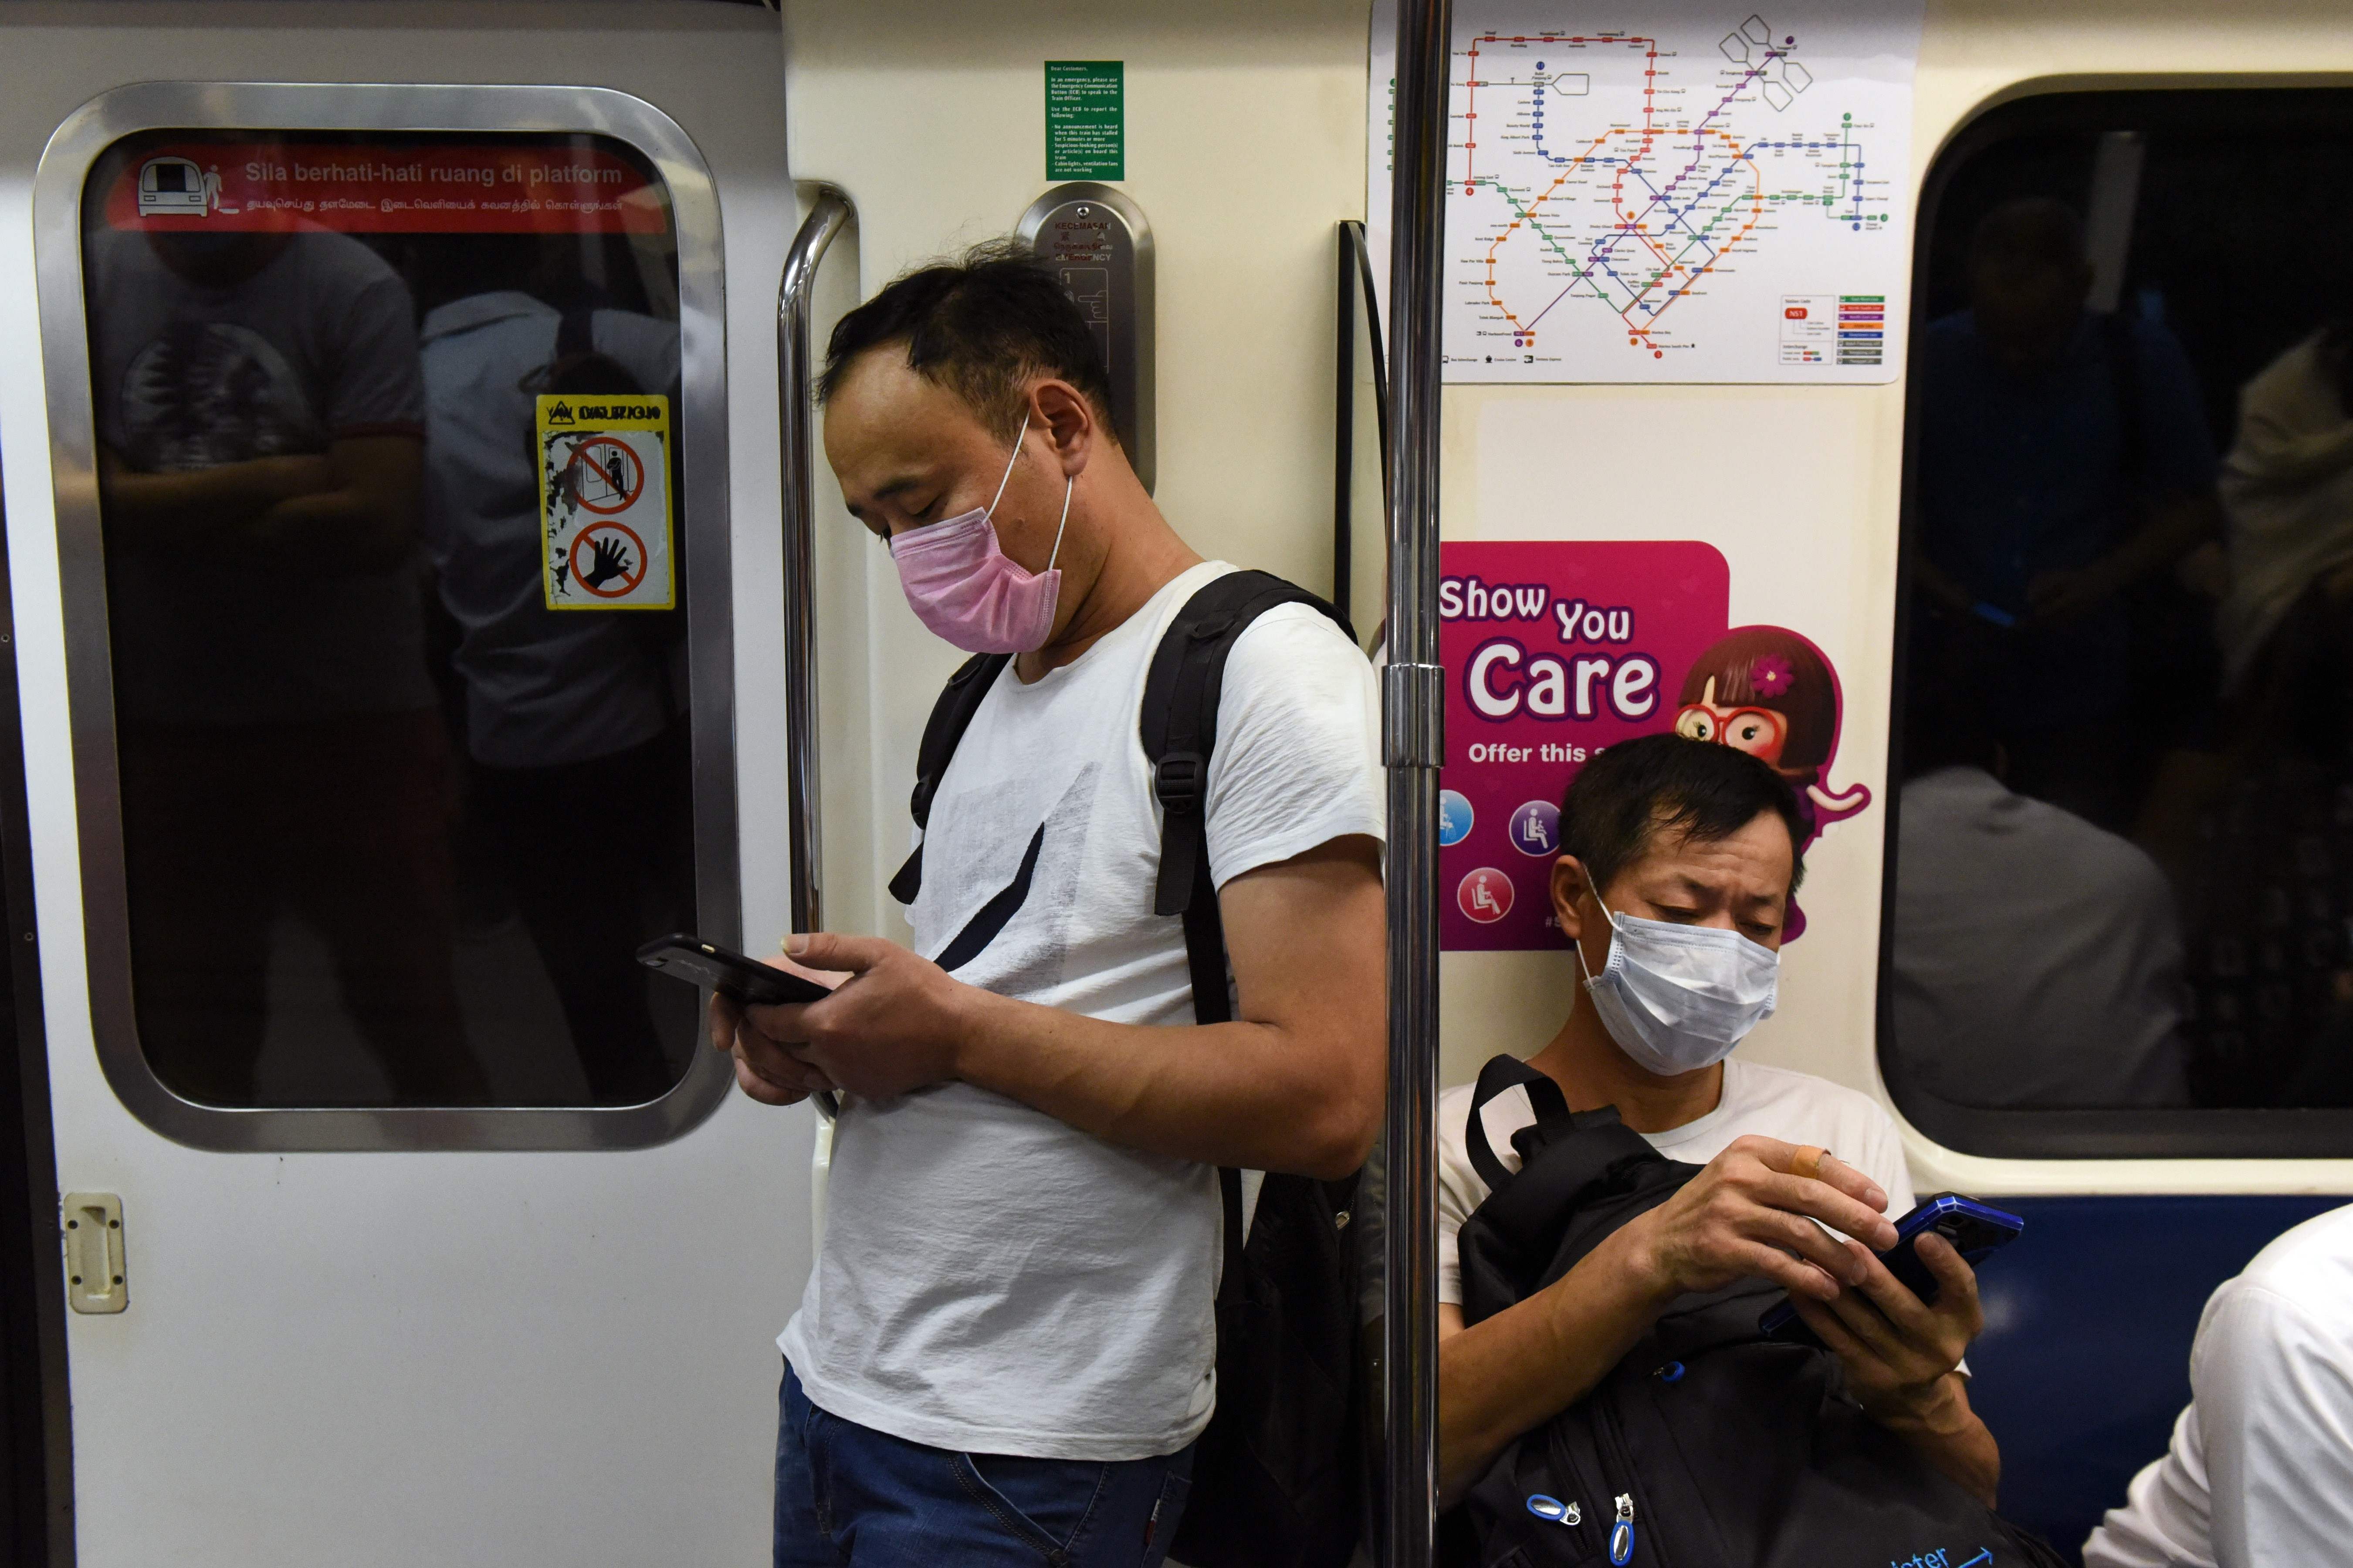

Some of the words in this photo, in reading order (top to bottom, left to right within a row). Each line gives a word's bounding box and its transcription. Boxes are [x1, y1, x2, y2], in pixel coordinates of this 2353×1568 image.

[246, 162, 287, 181] Sila
[295, 162, 422, 182] berhati-hati
[430, 167, 495, 187] ruang
[502, 164, 522, 183] di
[529, 164, 622, 187] platform
[1440, 580, 1545, 618] Show
[1556, 603, 1630, 641] You
[1469, 643, 1654, 717] Care
[1468, 743, 1533, 763] Offer
[1540, 743, 1586, 763] this
